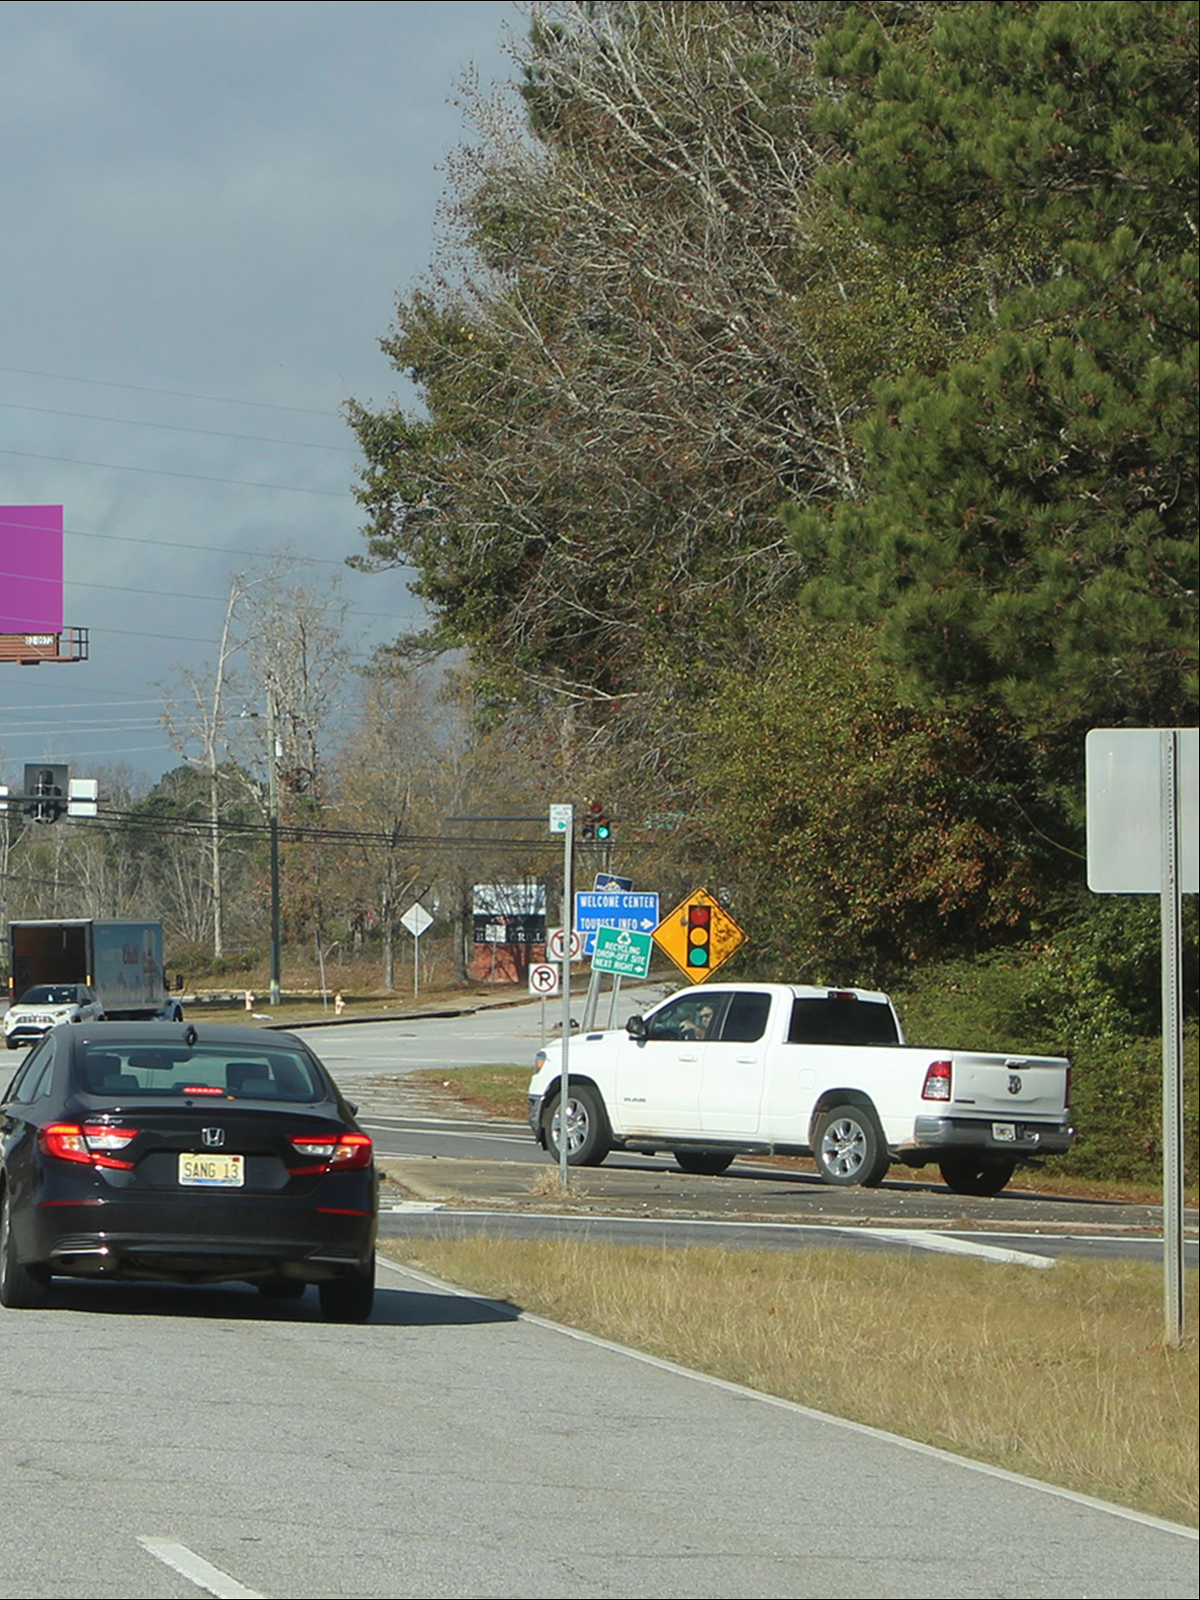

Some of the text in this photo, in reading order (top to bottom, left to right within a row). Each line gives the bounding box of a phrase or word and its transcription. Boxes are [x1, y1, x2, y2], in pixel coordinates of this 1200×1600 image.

[580, 895, 655, 909] WELCOME CENTER
[580, 917, 638, 931] TOURIST INFO
[605, 941, 641, 955] RECYCLING
[596, 948, 646, 965] DROP-OFF SITE
[595, 957, 634, 972] NEXT RIGHT
[184, 1161, 239, 1179] SANG 13
